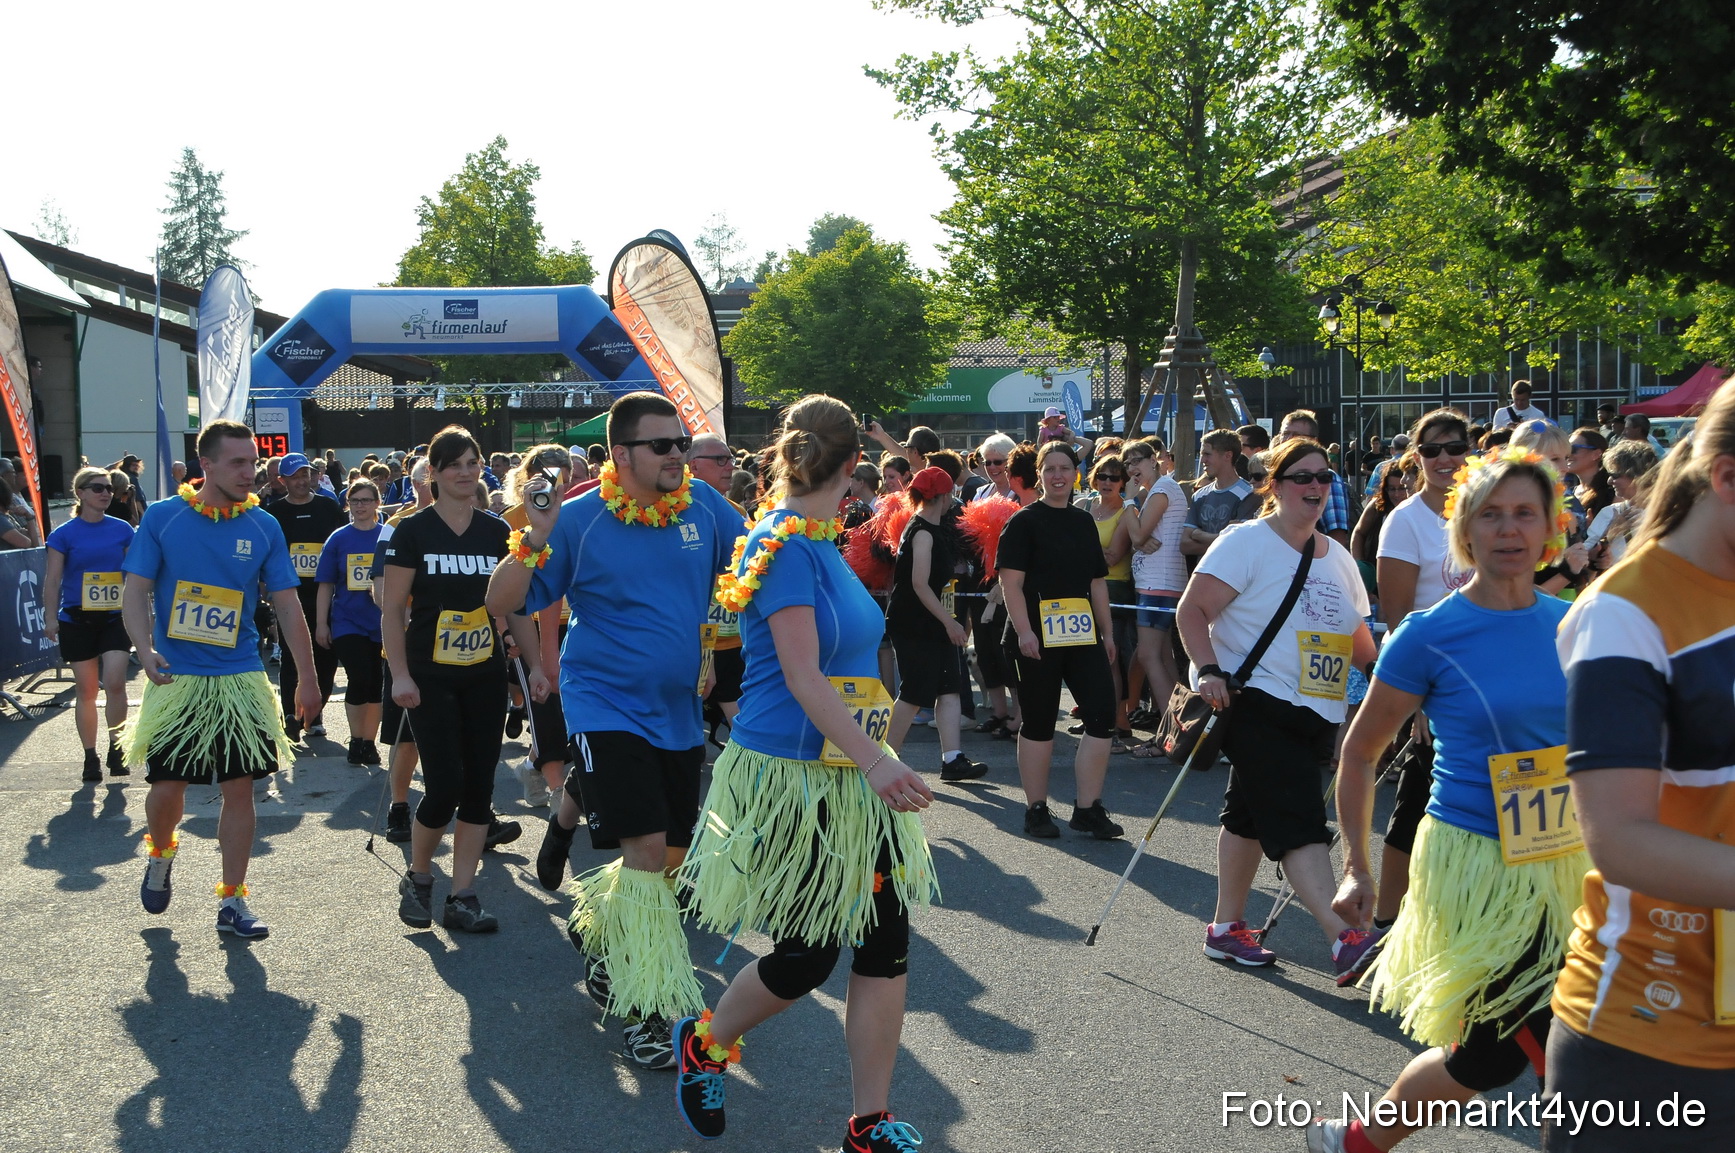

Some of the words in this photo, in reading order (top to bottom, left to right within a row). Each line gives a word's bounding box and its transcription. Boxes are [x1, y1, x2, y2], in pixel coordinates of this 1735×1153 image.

[432, 319, 508, 334] firmenlauf
[215, 289, 240, 393] Fischer
[283, 346, 326, 356] Fischer
[291, 554, 318, 569] 108
[423, 553, 498, 576] THULE
[353, 566, 373, 581] 67
[89, 585, 120, 601] 616
[175, 601, 237, 633] 1164
[1043, 613, 1092, 635] 1139
[438, 626, 492, 652] 1402
[1308, 653, 1343, 684] 502
[1501, 784, 1577, 836] 117
[1652, 931, 1676, 943] Audi
[1651, 986, 1674, 1004] FIAT
